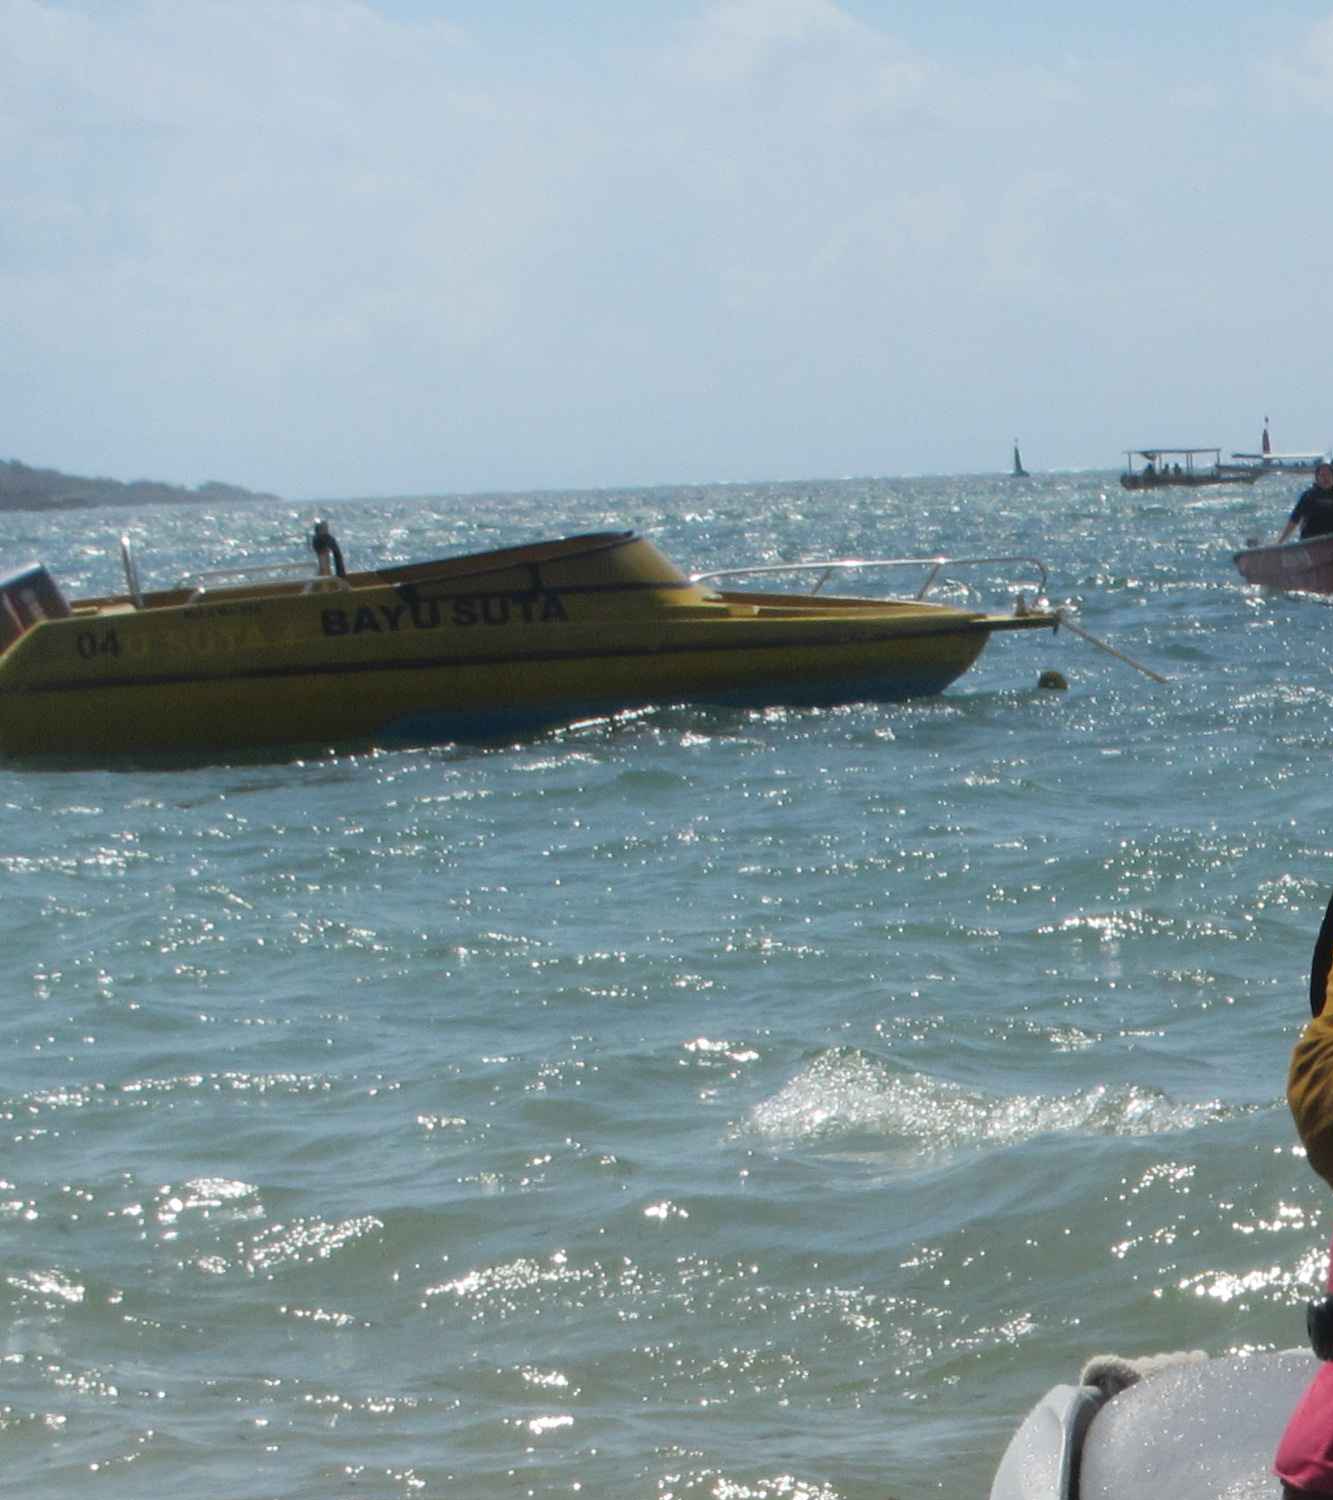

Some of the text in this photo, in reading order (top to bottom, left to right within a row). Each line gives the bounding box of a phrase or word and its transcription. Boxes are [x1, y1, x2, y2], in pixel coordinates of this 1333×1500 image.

[321, 597, 441, 637] BAYU
[451, 592, 570, 627] SUTA
[76, 628, 122, 660] 04
